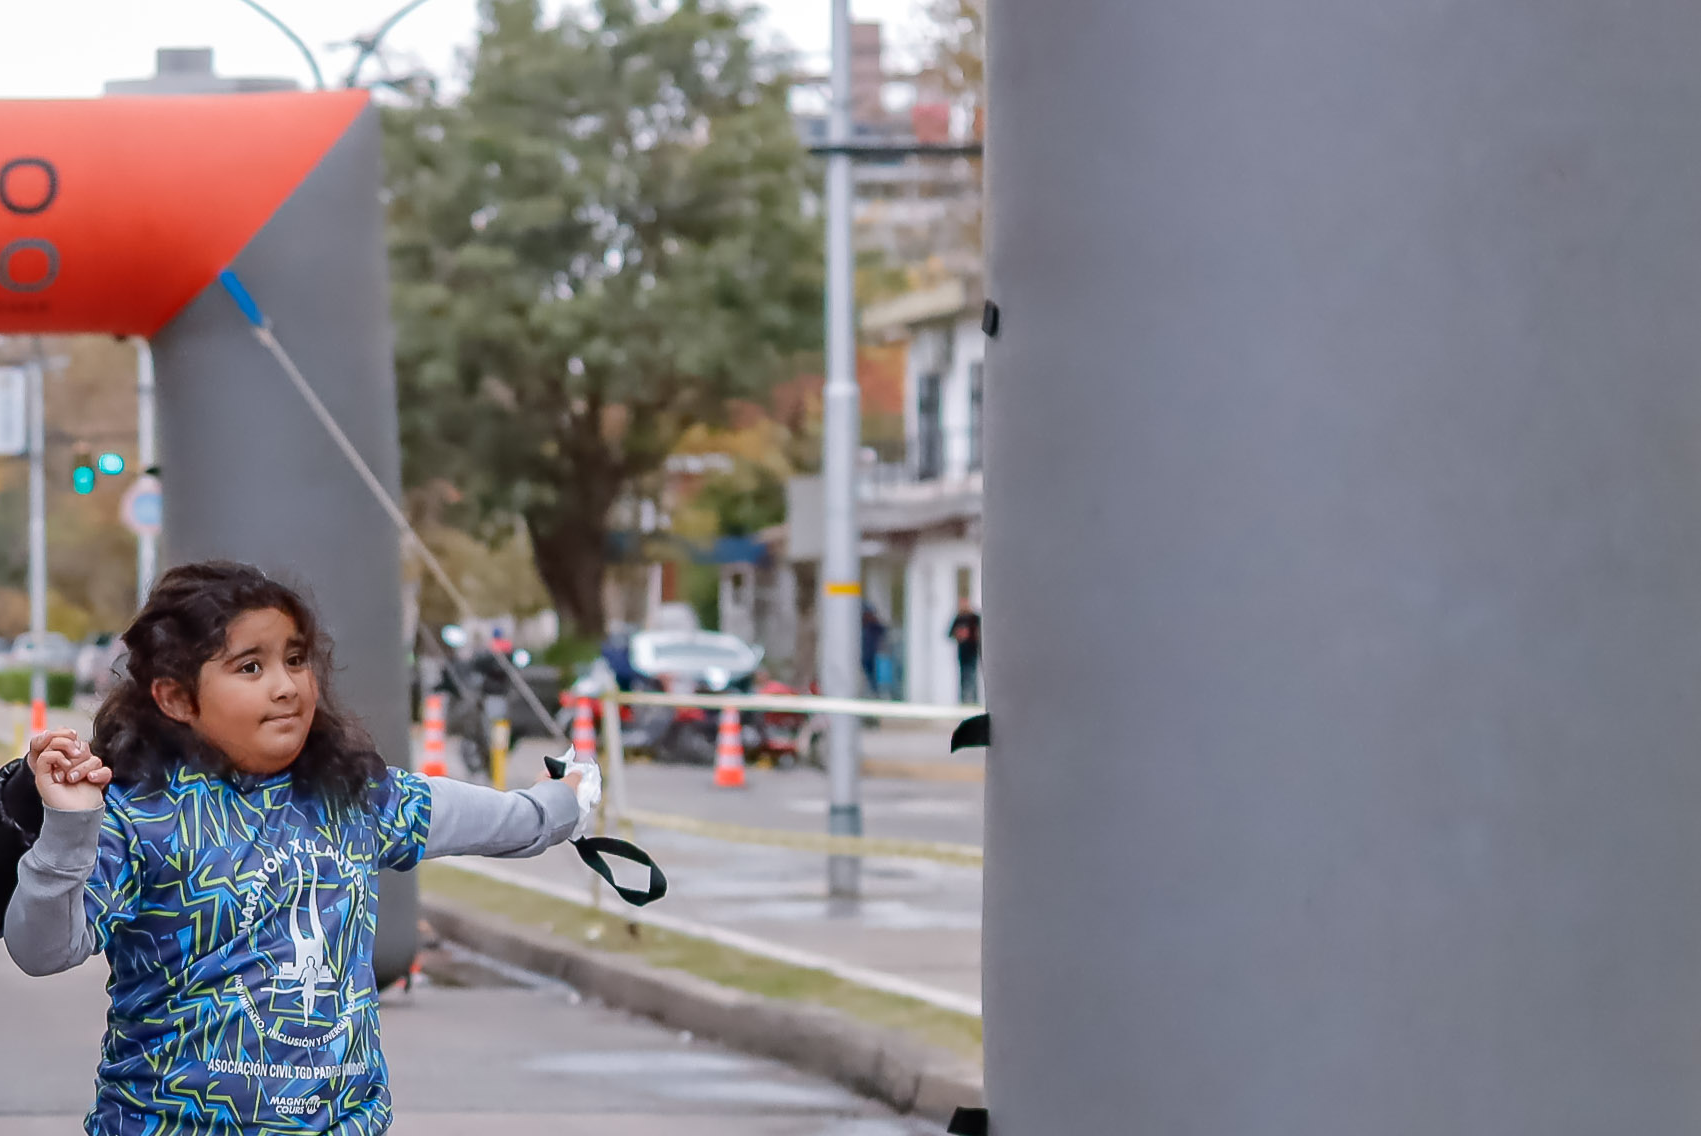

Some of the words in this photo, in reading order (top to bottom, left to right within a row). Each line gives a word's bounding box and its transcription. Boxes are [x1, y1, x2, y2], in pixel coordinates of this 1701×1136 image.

[238, 847, 290, 935] MARATÓN
[288, 838, 304, 854] X
[304, 838, 321, 854] EL
[266, 1026, 315, 1047] INCLUSIÓN
[207, 1058, 268, 1077] ASOCIACIÓN
[269, 1063, 294, 1079] CIVIL
[294, 1065, 312, 1079] TGD
[269, 1096, 306, 1106] MAGNY
[275, 1105, 304, 1115] COURS
